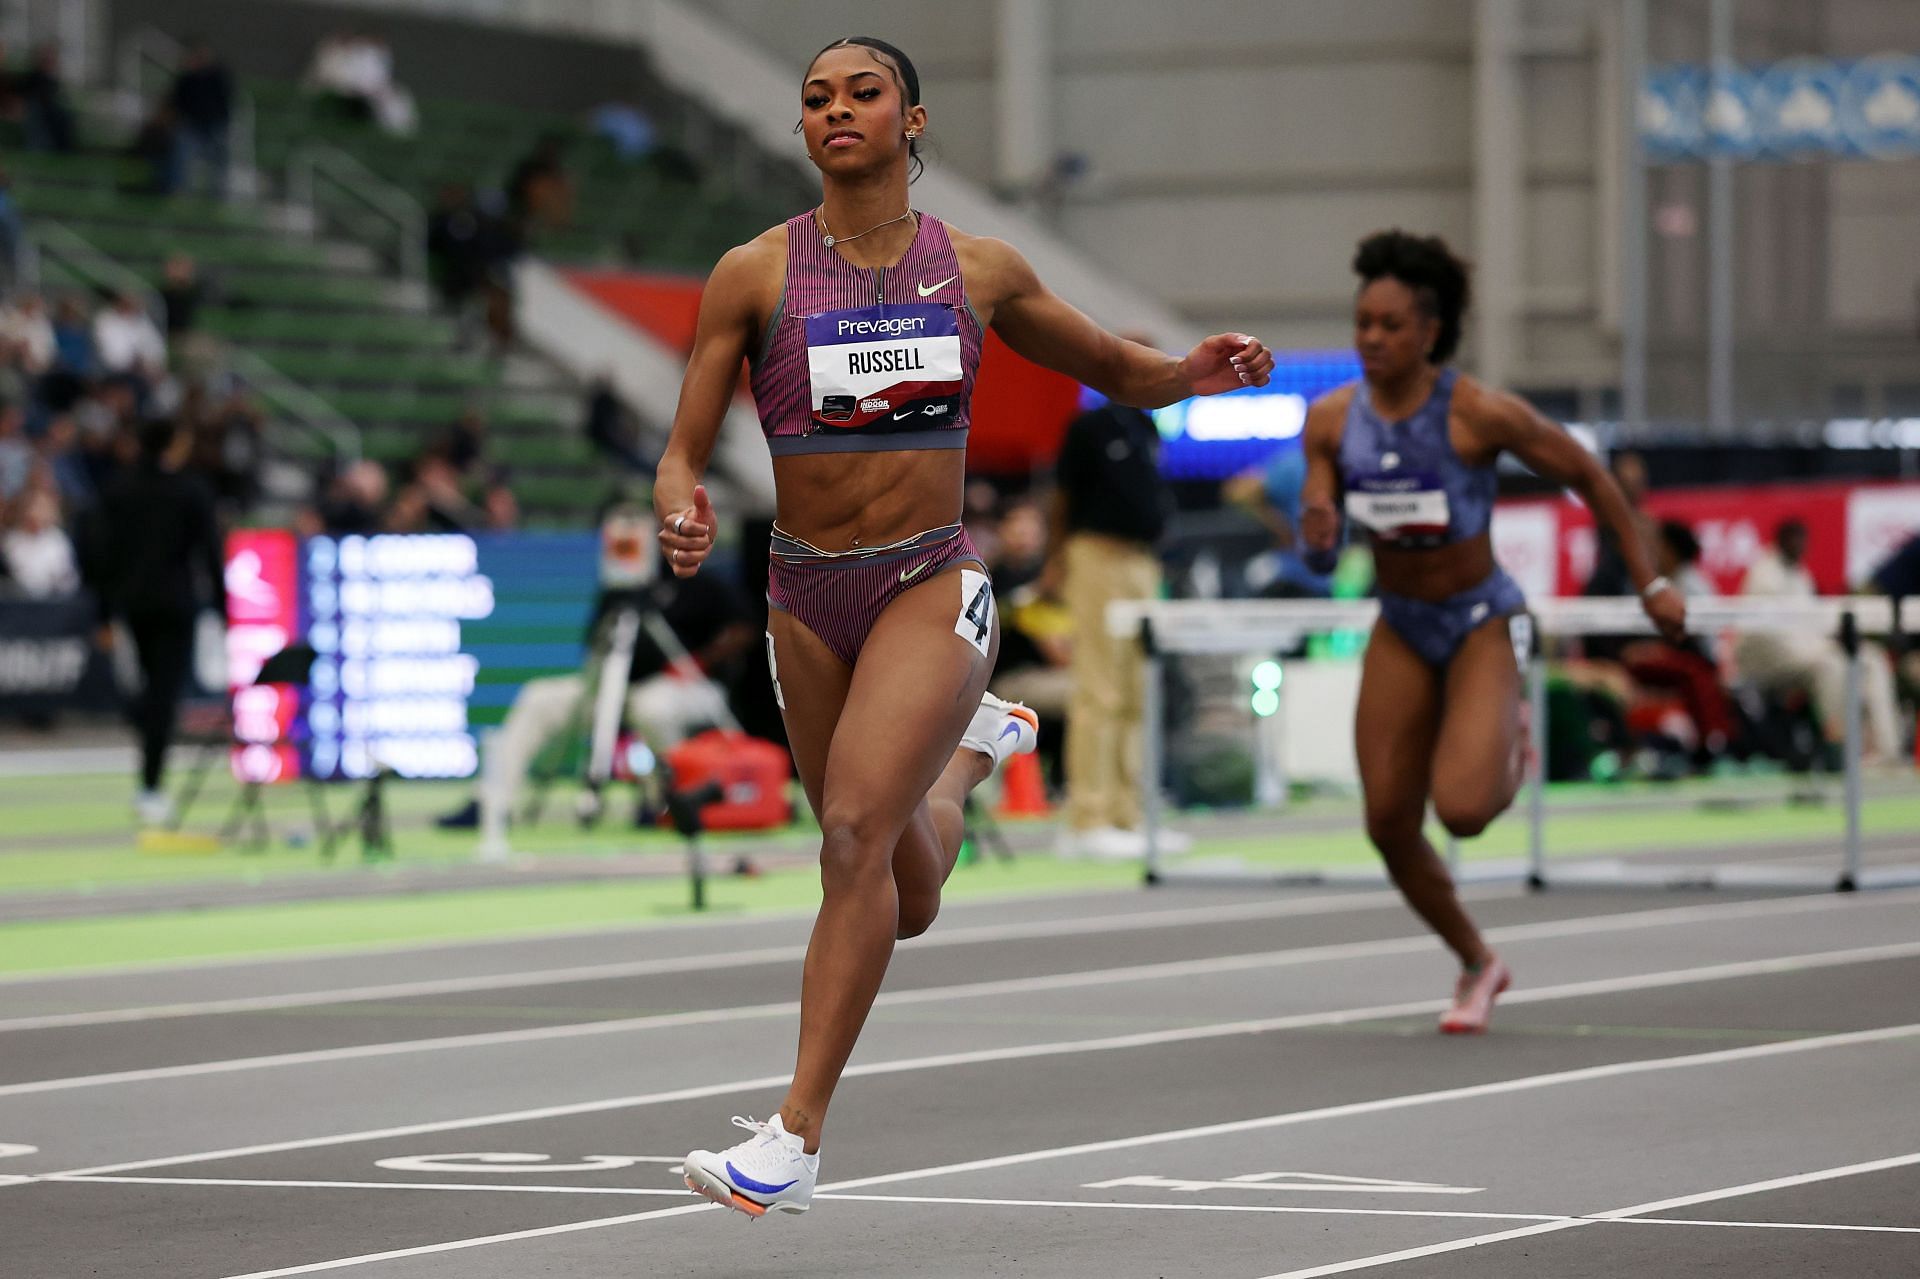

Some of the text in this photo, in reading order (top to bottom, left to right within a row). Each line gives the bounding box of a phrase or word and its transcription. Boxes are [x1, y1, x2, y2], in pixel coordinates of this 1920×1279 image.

[848, 347, 925, 375] RUSSELL
[965, 581, 991, 646] 4
[1080, 1171, 1488, 1194] 4
